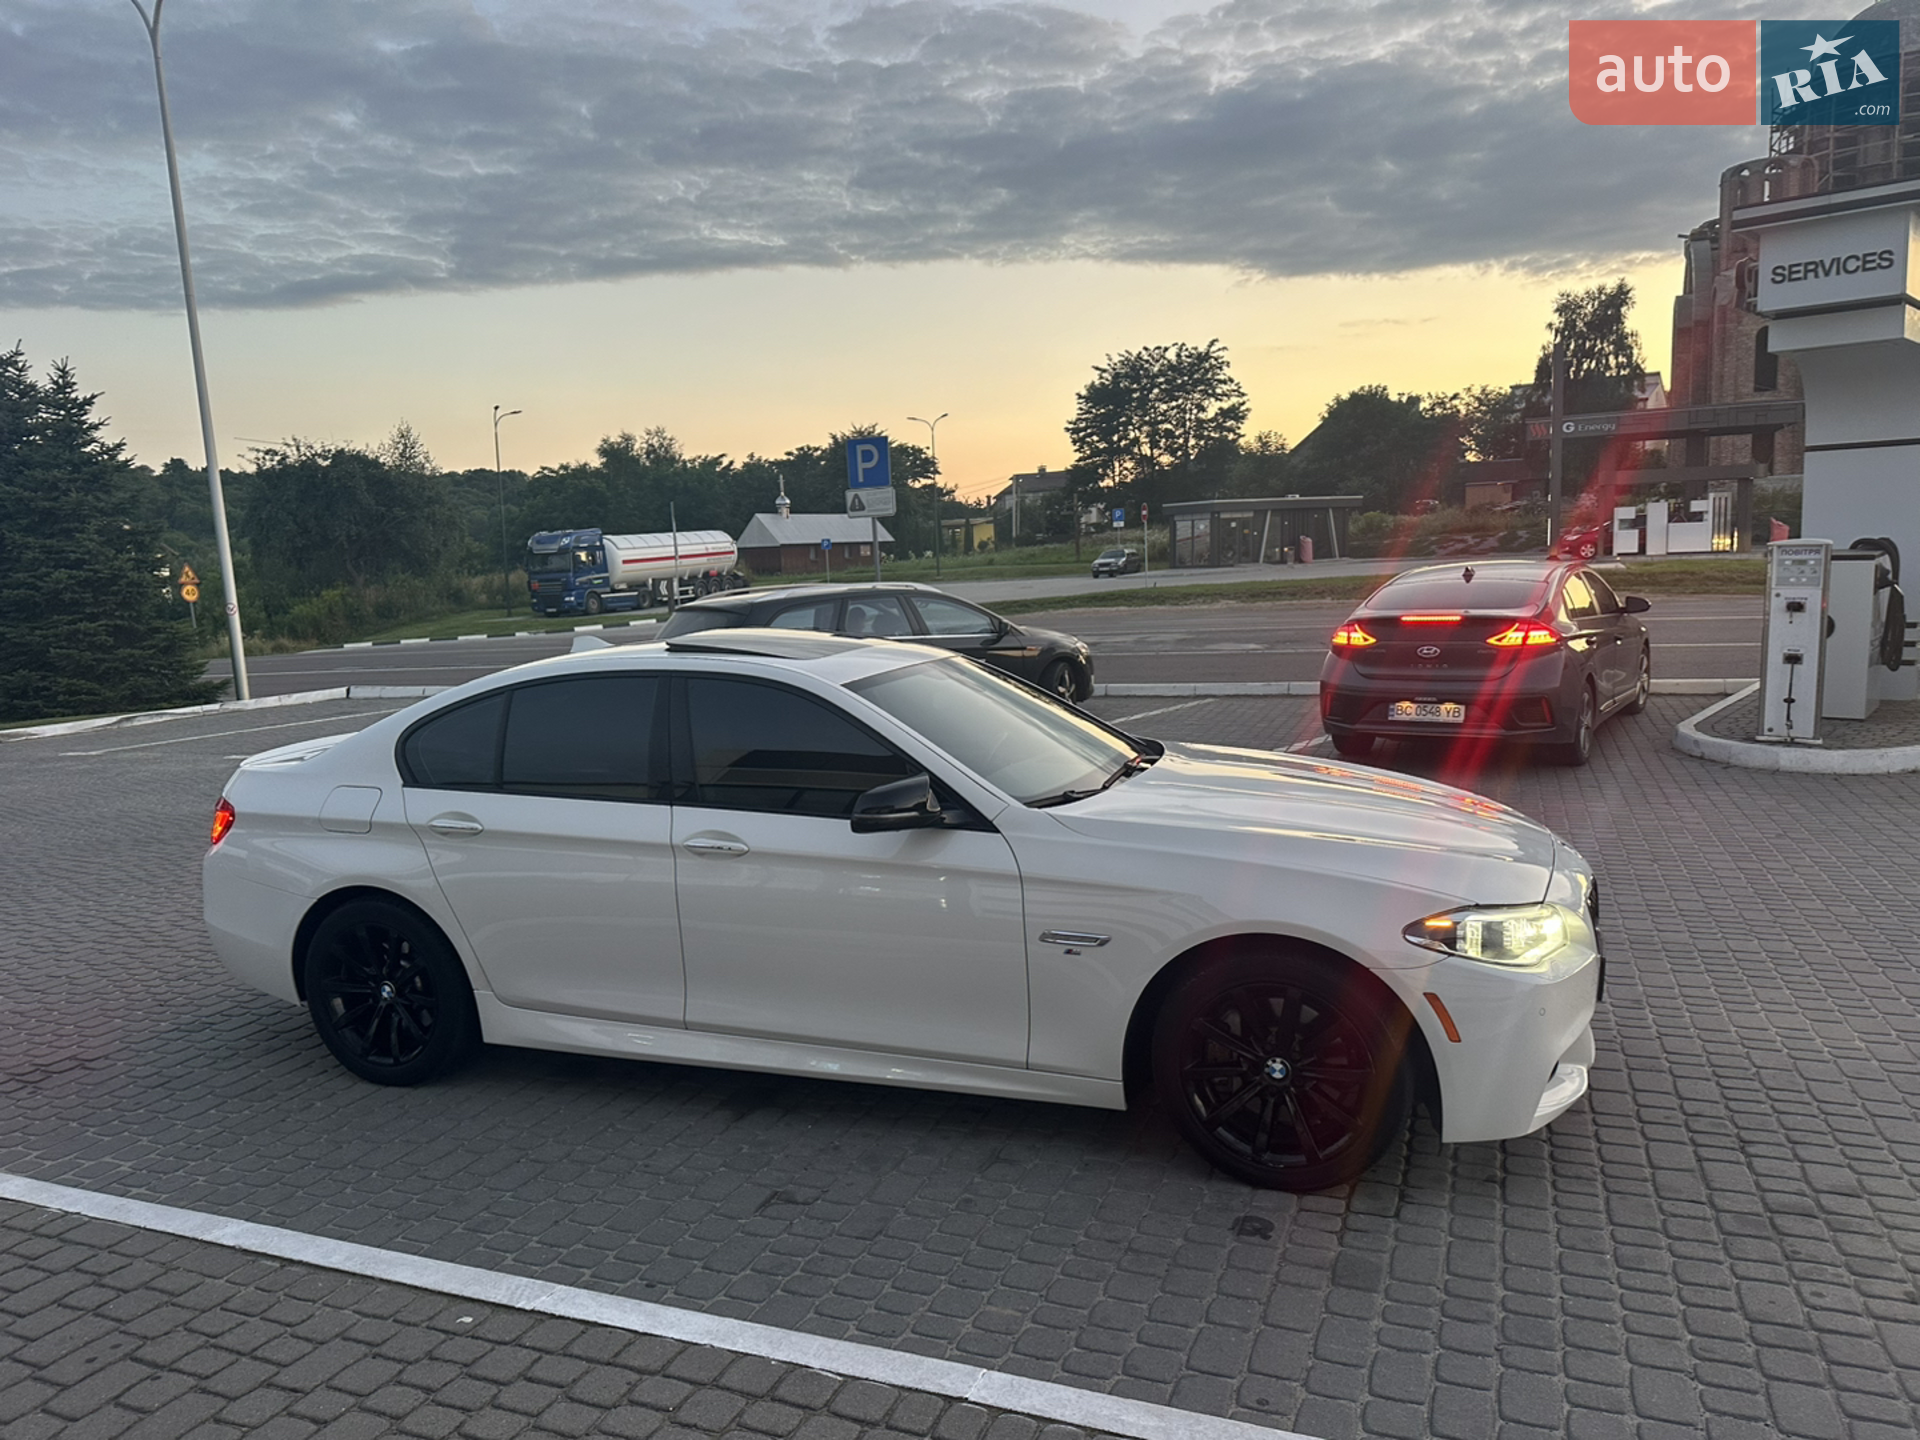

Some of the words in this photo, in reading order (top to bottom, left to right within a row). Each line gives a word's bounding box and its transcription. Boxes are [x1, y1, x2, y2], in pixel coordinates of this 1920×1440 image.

[1771, 249, 1895, 284] SERVICES
[1562, 421, 1576, 433] G
[1578, 423, 1616, 431] Energy
[856, 444, 879, 483] P
[1780, 548, 1821, 557] ПОВІТРЯ
[184, 588, 197, 597] 40
[1395, 704, 1413, 716] BC
[1415, 705, 1442, 717] 0548
[1444, 706, 1461, 718] YB
